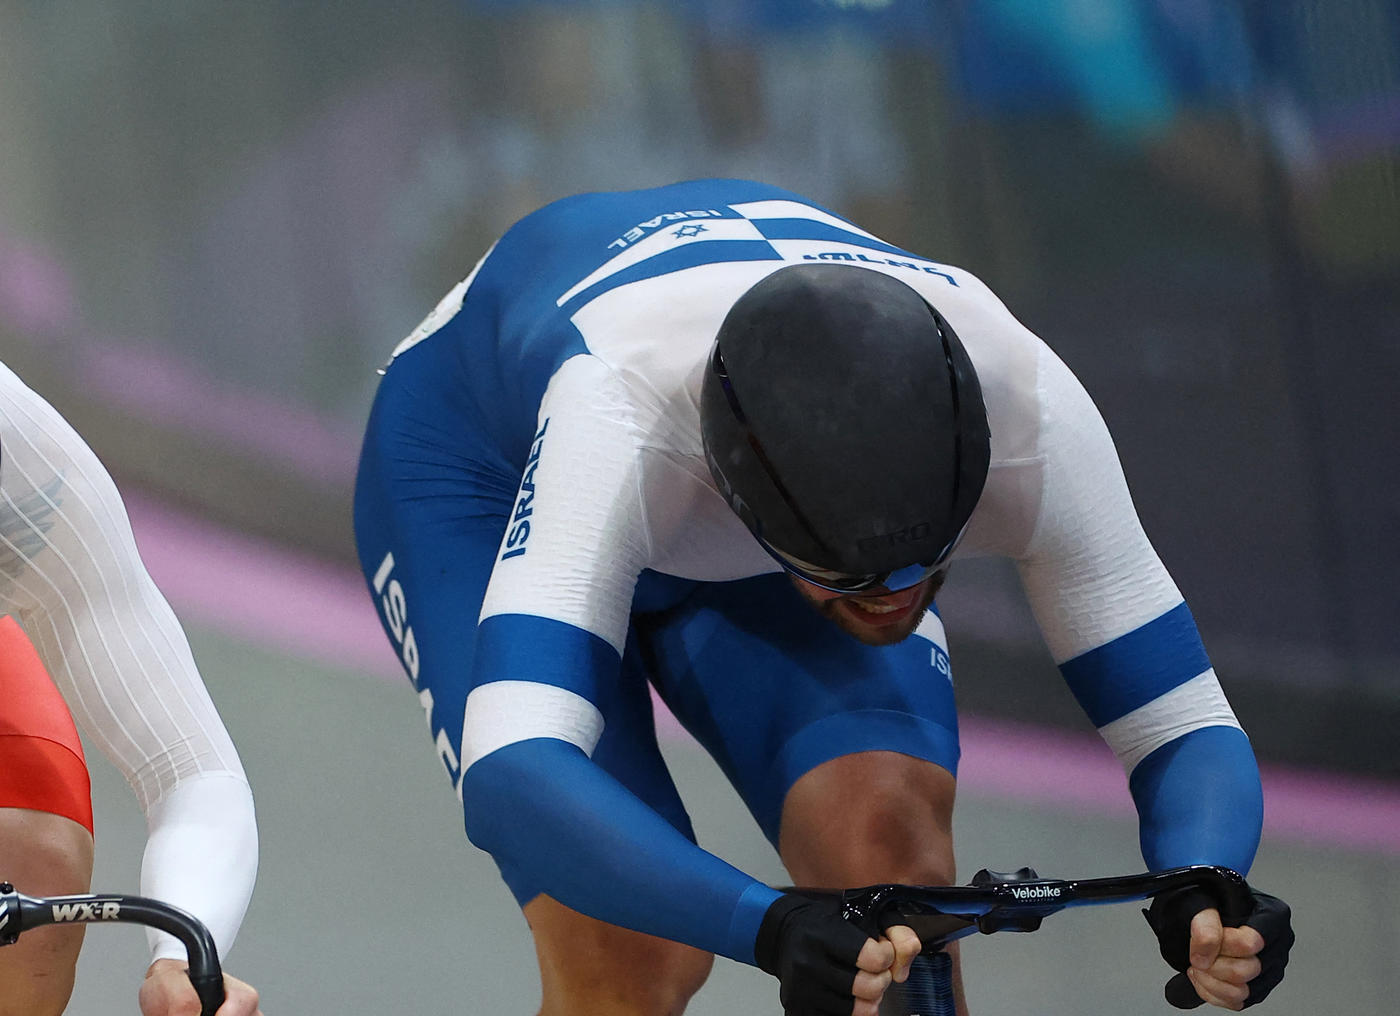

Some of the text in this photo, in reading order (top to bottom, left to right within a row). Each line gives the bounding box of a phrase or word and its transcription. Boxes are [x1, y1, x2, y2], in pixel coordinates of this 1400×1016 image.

[607, 209, 723, 249] ISRAEL
[501, 416, 551, 562] ISRAEL
[1011, 886, 1061, 900] Velobike
[51, 902, 121, 922] WX-R
